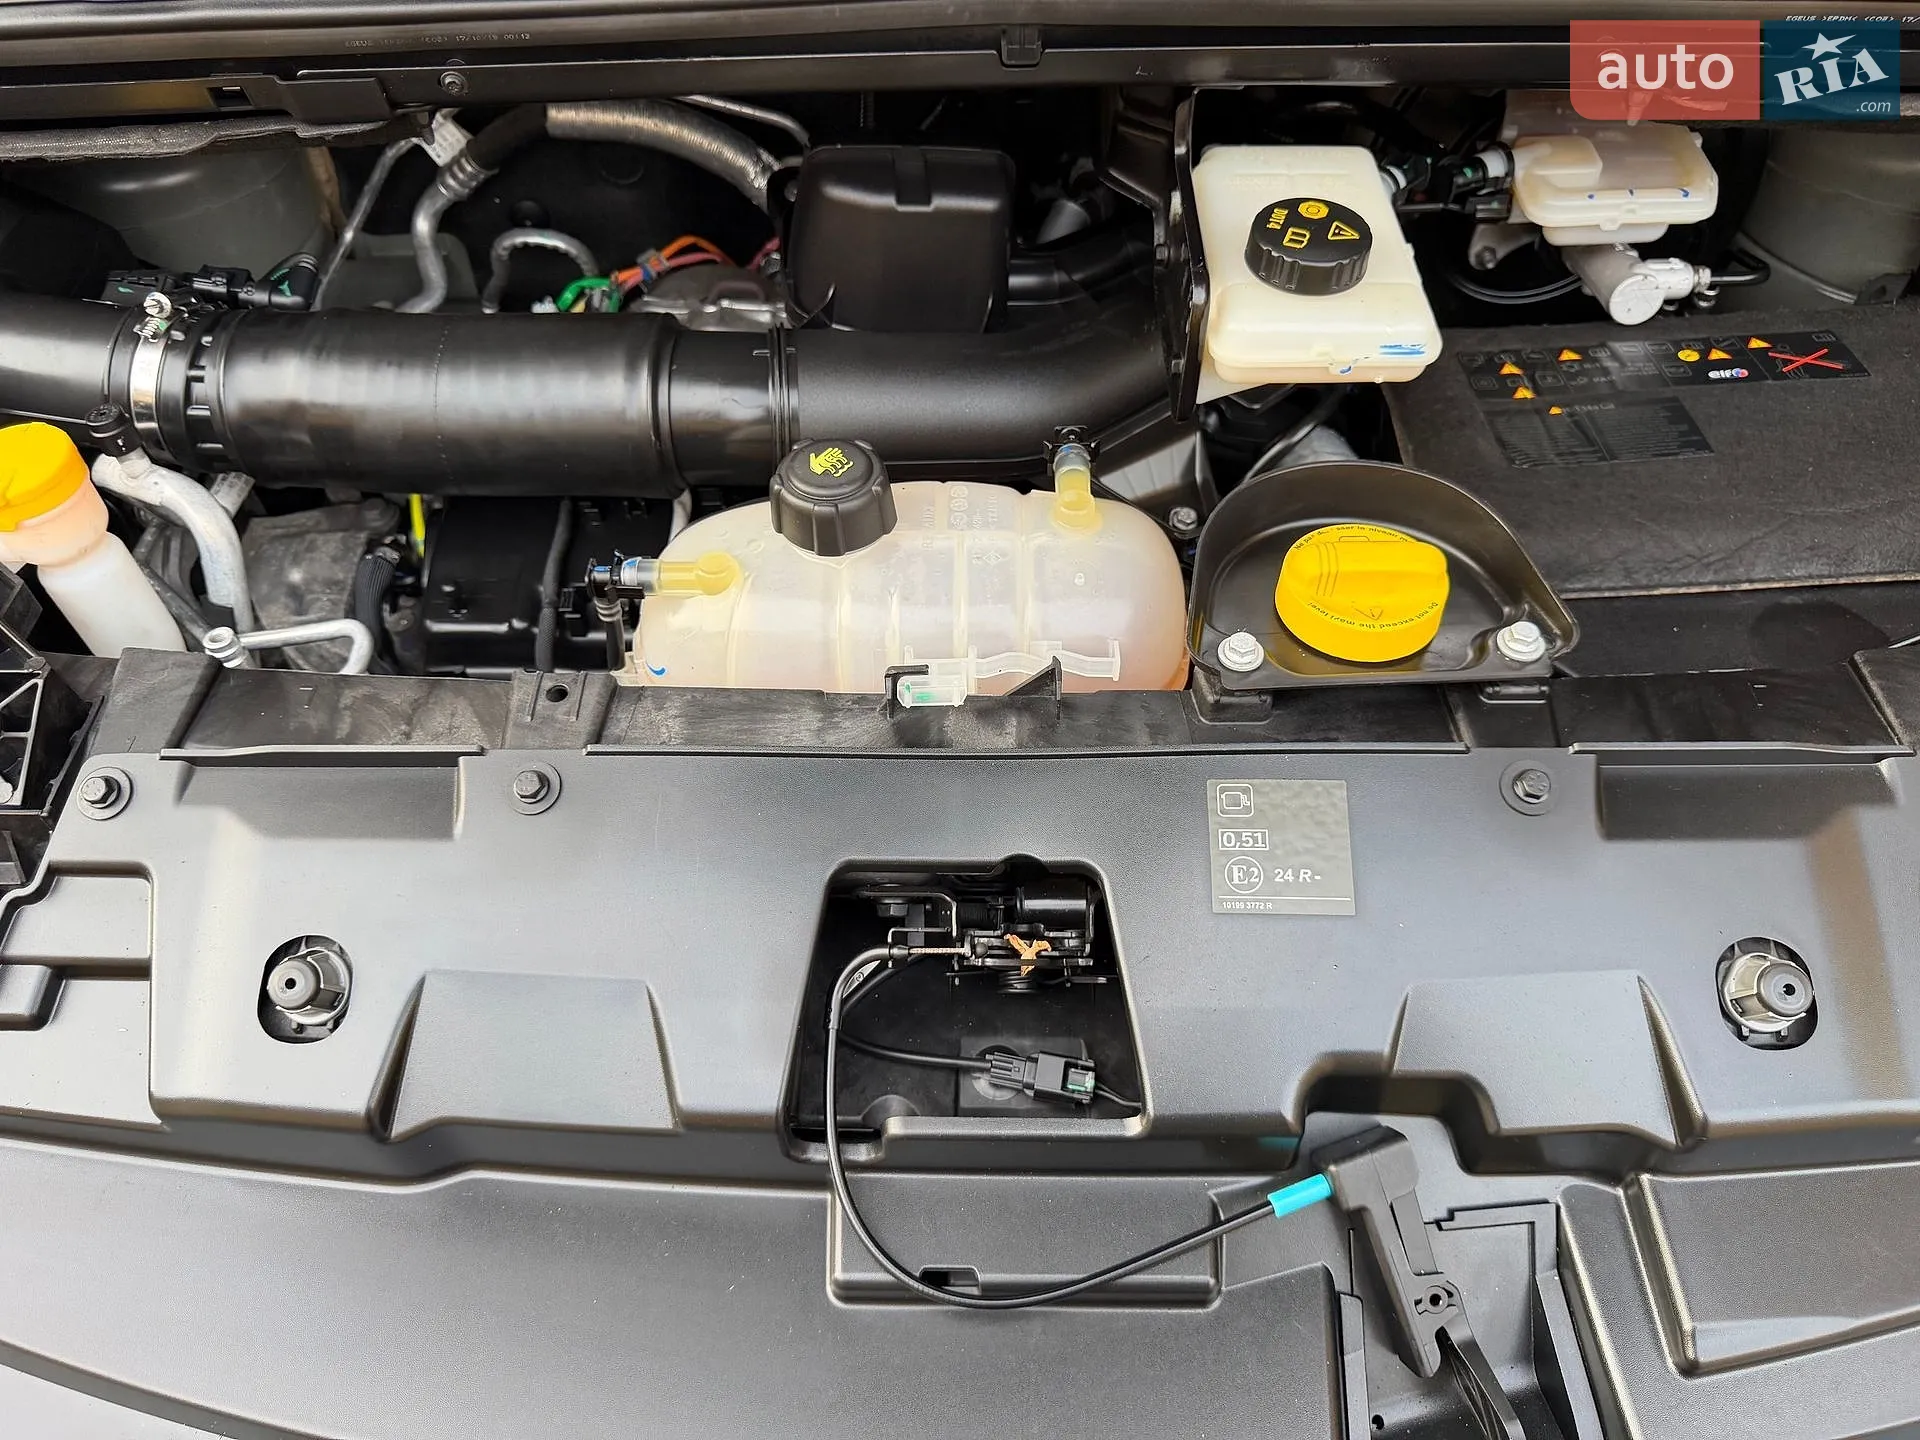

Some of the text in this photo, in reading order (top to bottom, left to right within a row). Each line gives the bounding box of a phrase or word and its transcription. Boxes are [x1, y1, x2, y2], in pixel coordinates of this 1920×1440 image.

[1427, 601, 1439, 610] Do
[1415, 609, 1429, 619] not
[1358, 622, 1376, 630] the
[1379, 617, 1415, 629] exceed
[1222, 832, 1266, 849] 0,51
[1230, 864, 1260, 885] E2
[1274, 868, 1295, 882] 24
[1266, 902, 1273, 910] R
